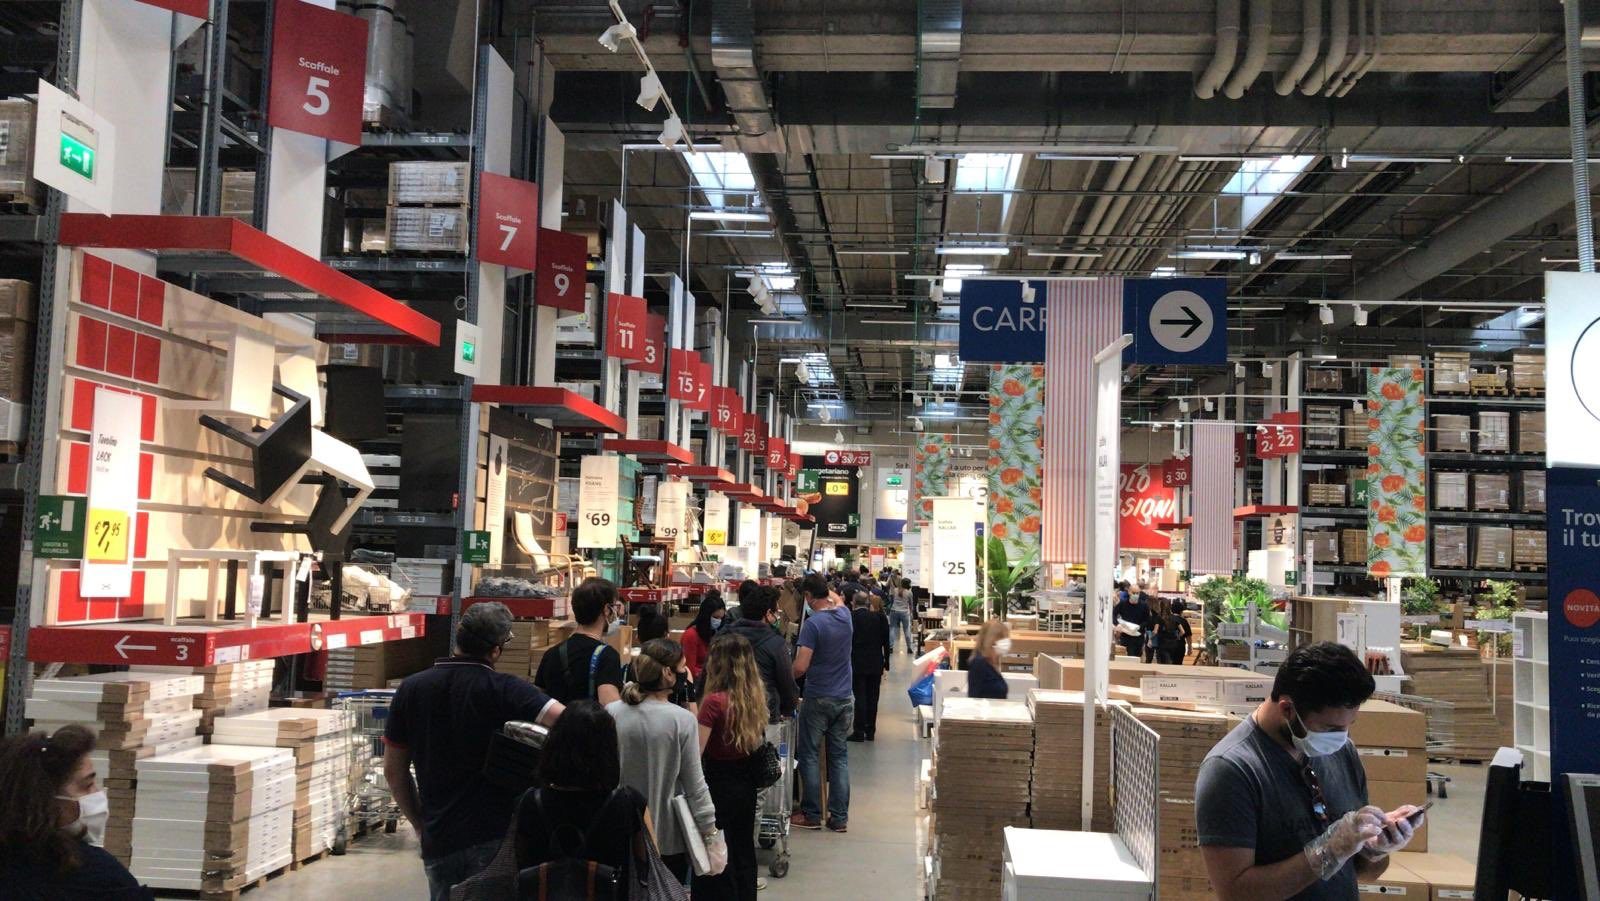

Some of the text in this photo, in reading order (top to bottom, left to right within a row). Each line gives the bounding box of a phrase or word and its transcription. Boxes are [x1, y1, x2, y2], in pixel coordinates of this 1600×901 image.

[298, 56, 340, 76] Scaffale
[303, 76, 330, 116] 5
[496, 212, 522, 224] Scaffale
[499, 224, 518, 252] 7
[554, 273, 570, 297] 9
[619, 329, 634, 349] 11
[678, 376, 694, 393] 15
[717, 408, 731, 423] 19
[743, 432, 756, 444] 23
[1278, 434, 1294, 447] 22
[770, 453, 781, 464] 27
[1175, 471, 1188, 481] 30
[586, 512, 611, 526] €69
[1563, 528, 1575, 546] il
[175, 644, 189, 661] 3
